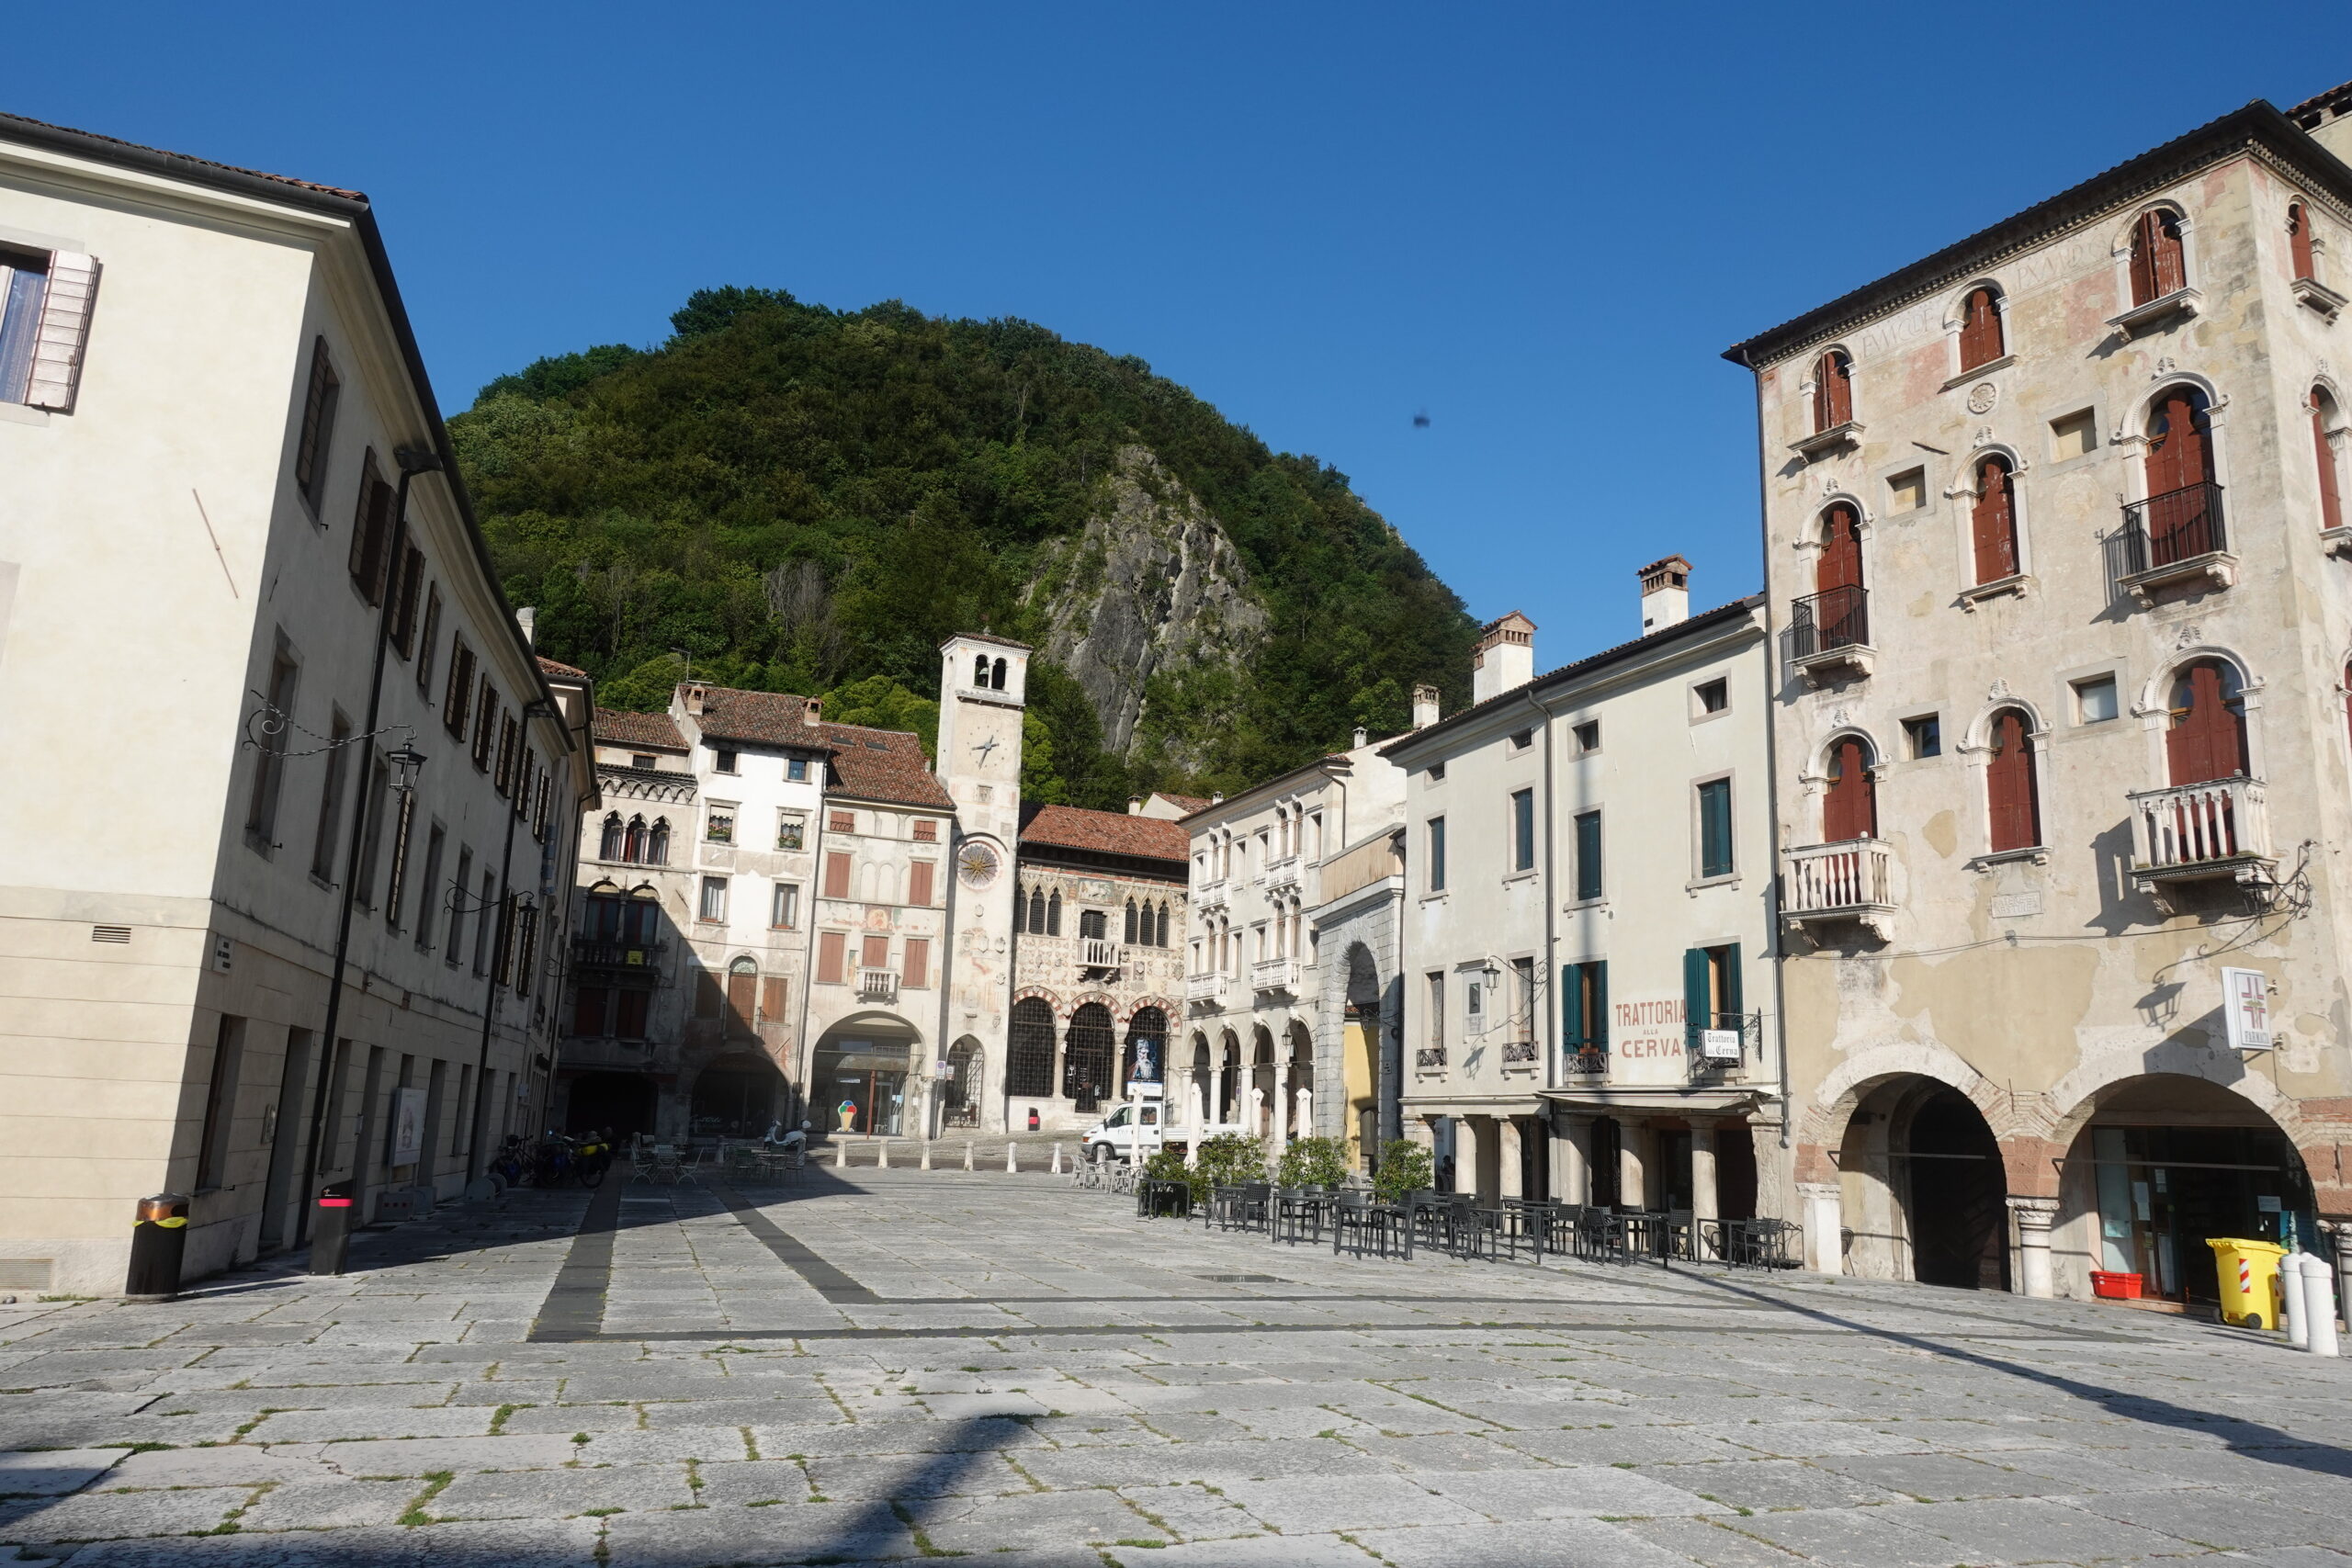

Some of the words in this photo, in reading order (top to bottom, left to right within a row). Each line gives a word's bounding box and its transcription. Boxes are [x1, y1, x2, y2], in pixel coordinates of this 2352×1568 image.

[1616, 999, 1686, 1027] TRATTORIA
[1707, 1032, 1736, 1043] Trattoria
[1622, 1038, 1681, 1058] CERVA
[1715, 1045, 1738, 1055] Cerva
